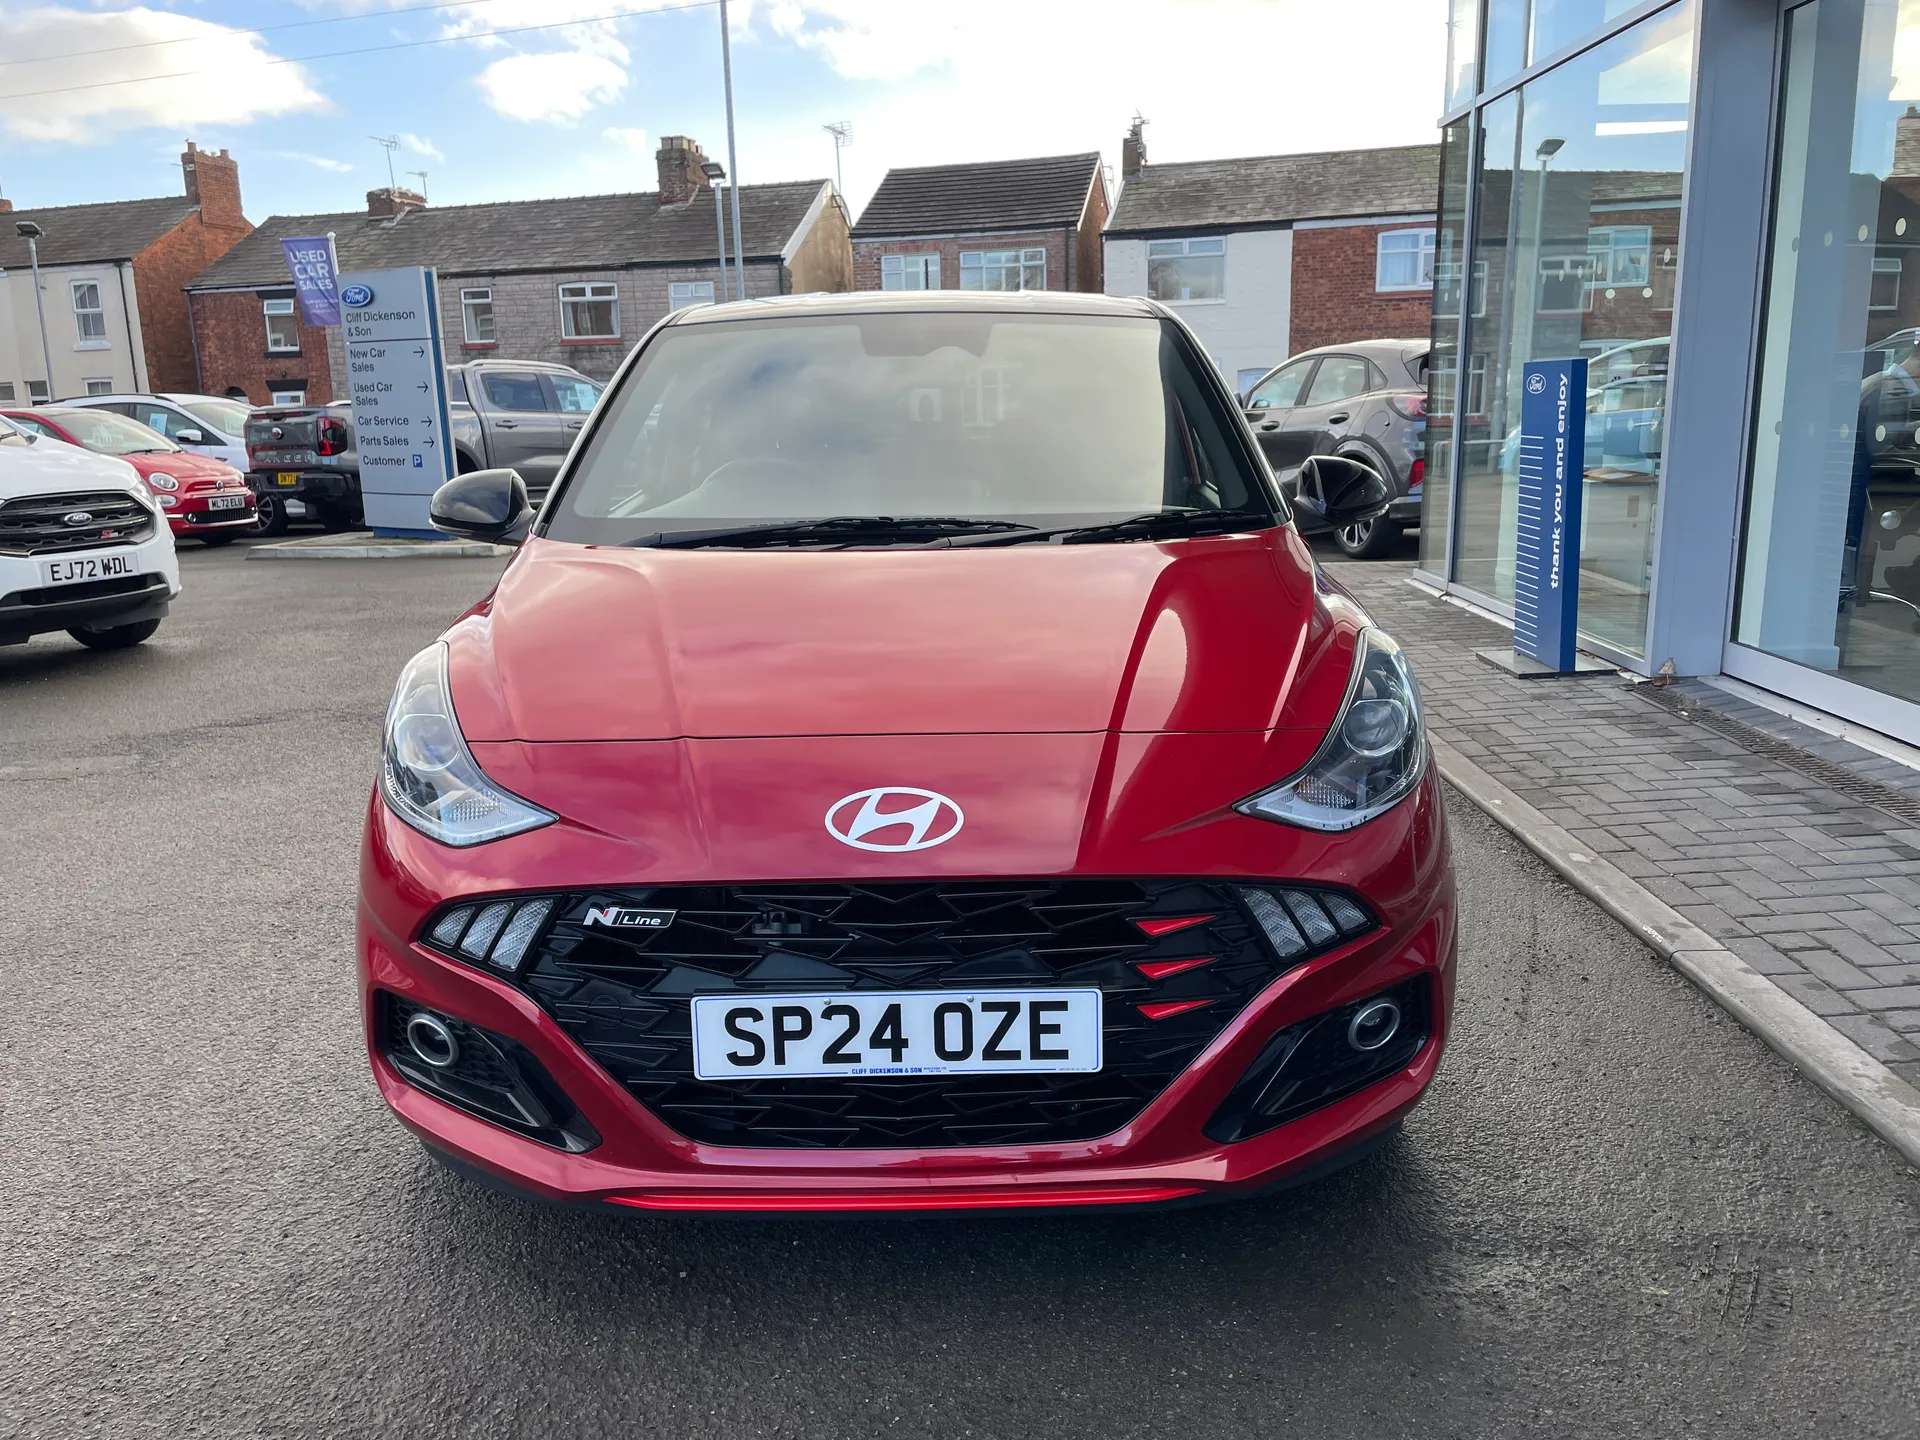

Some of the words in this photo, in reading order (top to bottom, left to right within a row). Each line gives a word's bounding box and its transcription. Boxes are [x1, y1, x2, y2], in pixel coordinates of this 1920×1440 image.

[290, 249, 327, 262] USED
[294, 263, 329, 278] CAR
[299, 279, 333, 290] SALES
[346, 312, 362, 323] Cliff
[363, 311, 416, 321] Dickenson
[347, 327, 354, 337] &
[354, 326, 372, 337] Son
[350, 348, 368, 359] New
[369, 347, 386, 358] Car
[351, 362, 375, 373] Sales
[354, 382, 375, 393] Used
[376, 382, 393, 392] Car
[355, 395, 379, 406] Sales
[1557, 373, 1568, 433] enjoy
[358, 416, 372, 426] Car
[373, 416, 409, 426] Service
[360, 435, 382, 446] Parts
[383, 435, 409, 446] Sales
[363, 455, 406, 466] Customer
[1555, 437, 1564, 480] and
[211, 498, 230, 508] ML72
[1554, 484, 1563, 523] you
[1551, 527, 1561, 589] thank
[50, 560, 97, 581] EJ72
[101, 556, 133, 576] WDL
[583, 907, 620, 926] N
[622, 916, 661, 925] Line
[724, 1003, 909, 1067] SP24
[933, 1000, 1069, 1062] OZE
